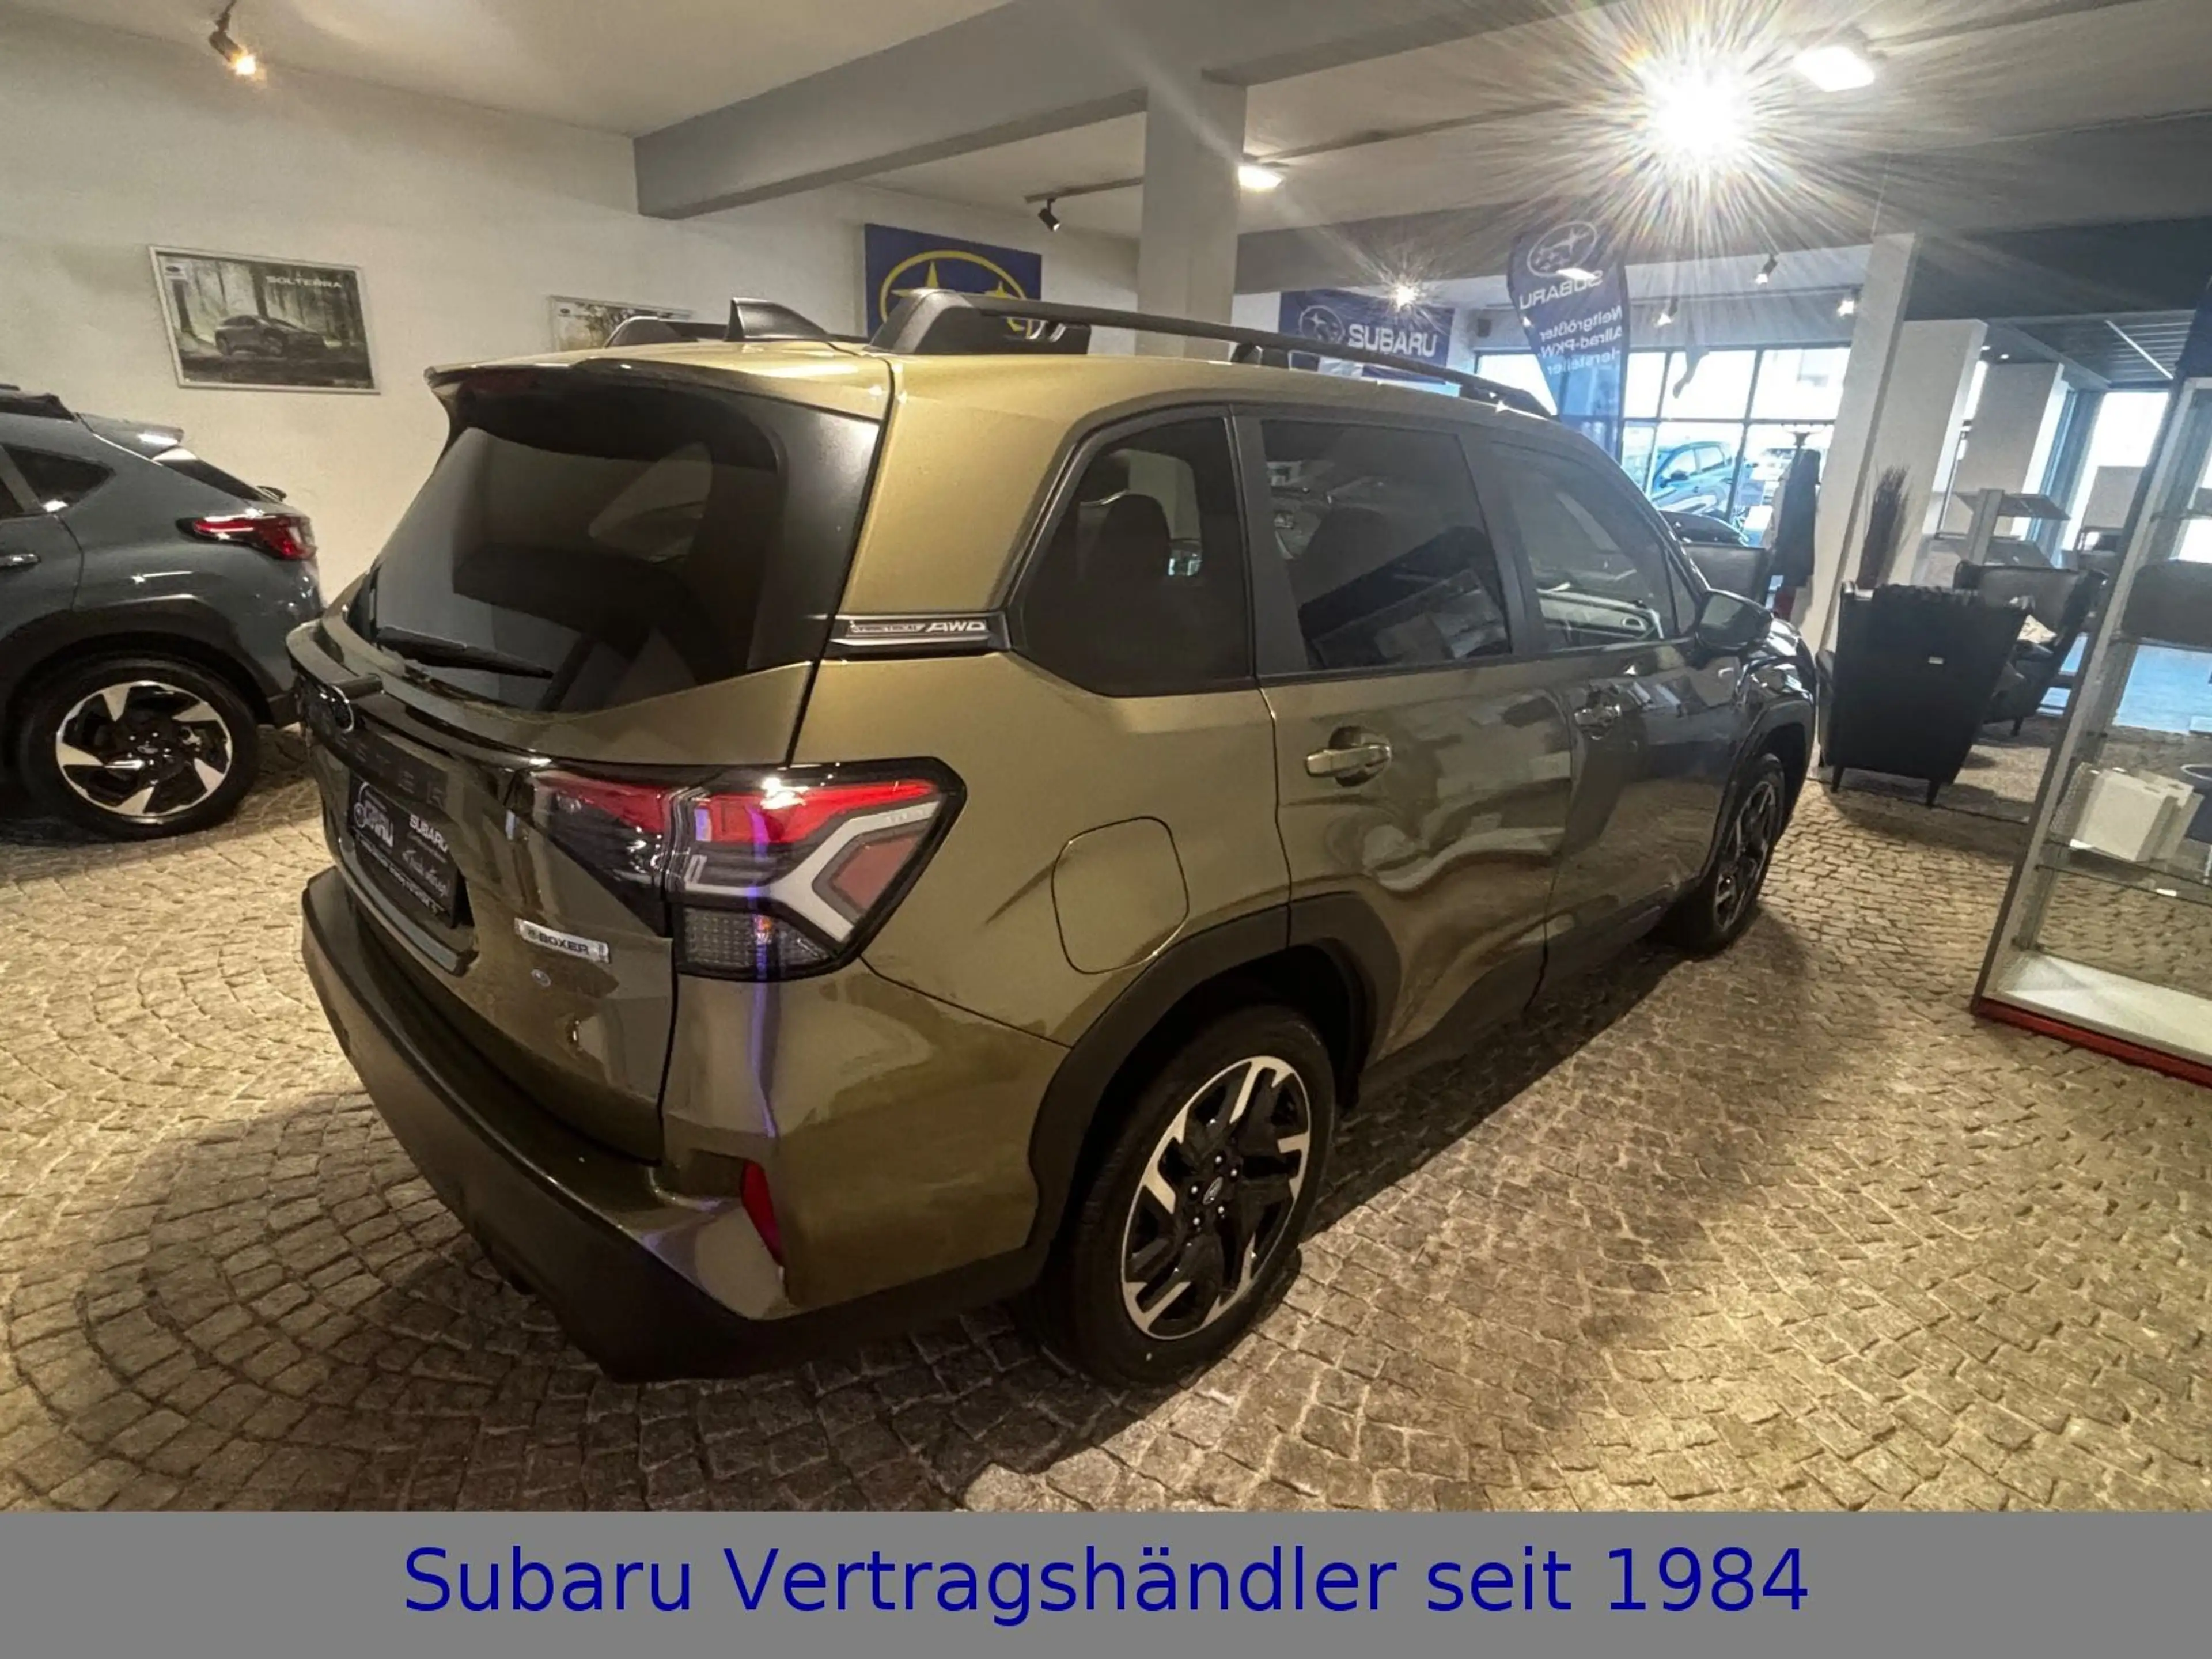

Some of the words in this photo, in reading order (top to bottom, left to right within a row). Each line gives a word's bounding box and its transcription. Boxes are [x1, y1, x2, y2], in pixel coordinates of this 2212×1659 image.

[1348, 324, 1438, 358] SUBARU
[925, 620, 986, 633] AWD
[410, 813, 448, 853] SUBARU
